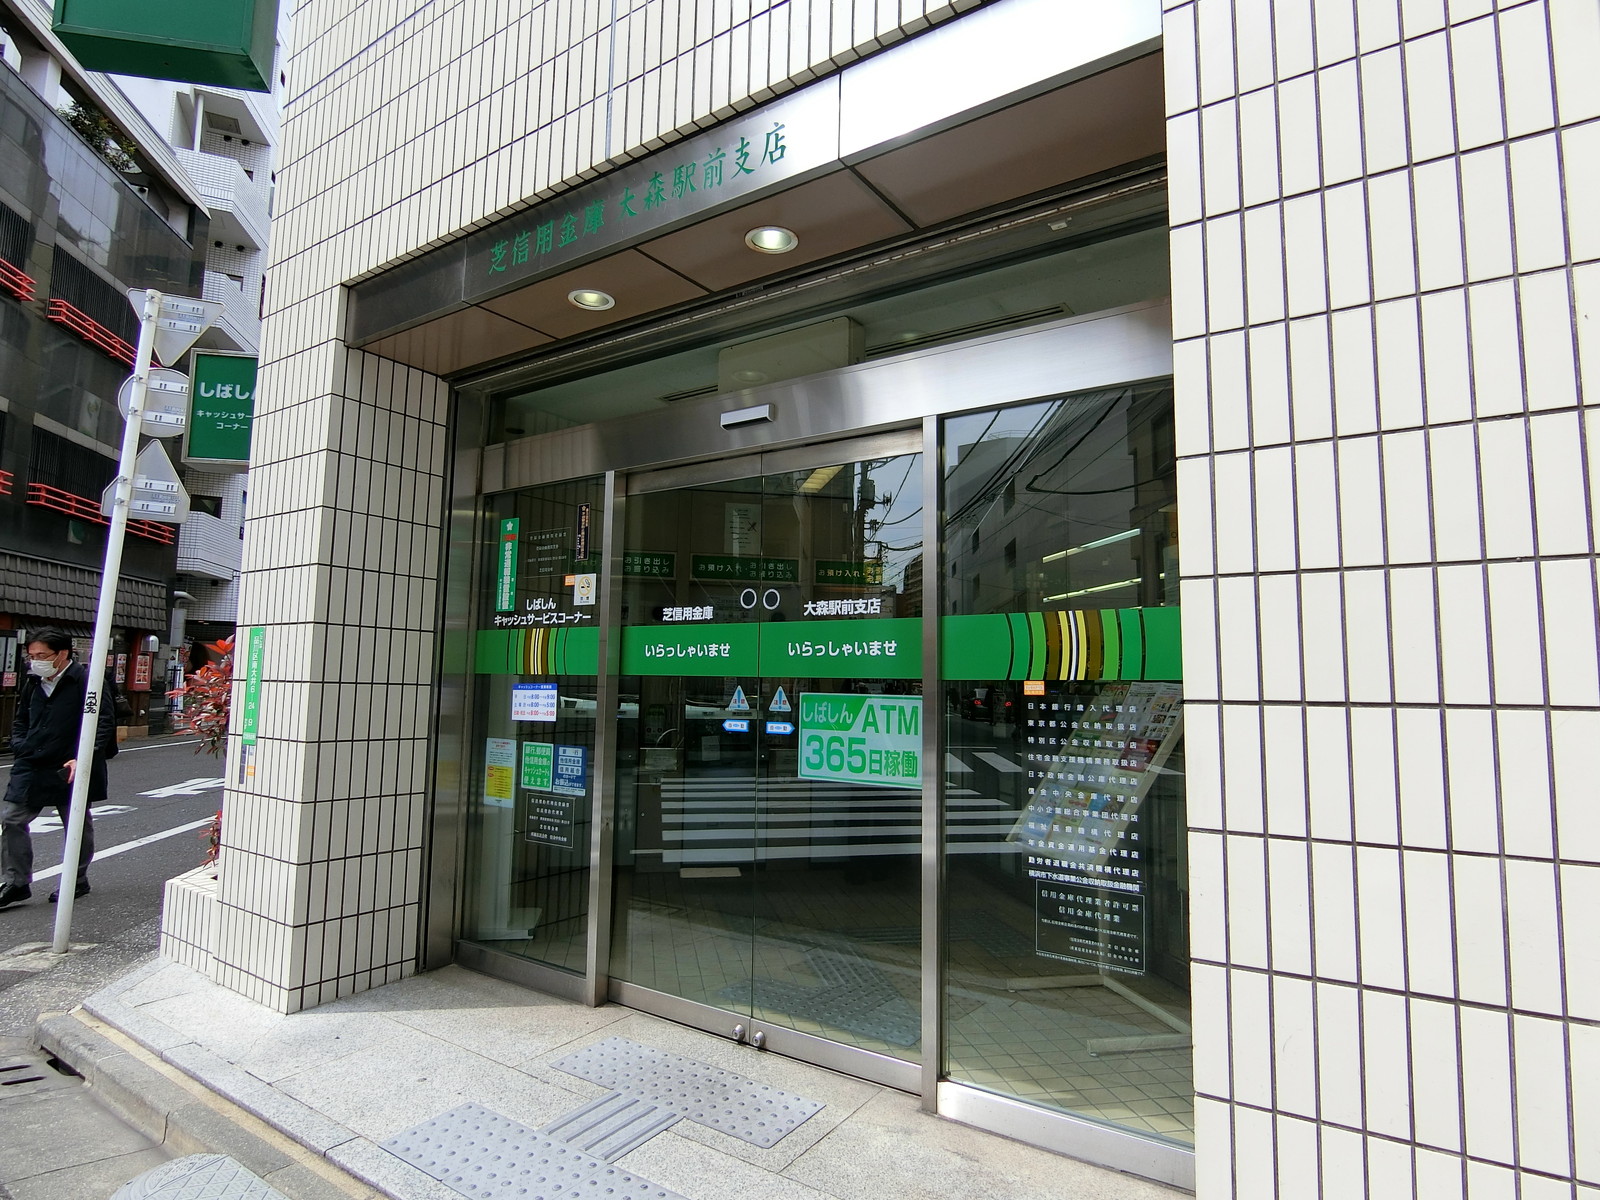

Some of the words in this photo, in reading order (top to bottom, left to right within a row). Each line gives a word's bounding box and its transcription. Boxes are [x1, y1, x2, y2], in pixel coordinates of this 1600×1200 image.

[488, 198, 606, 275] 芝信用金庫
[616, 122, 788, 219] 大森駅前支店
[199, 381, 256, 400] しばし
[216, 422, 248, 430] コーナー
[526, 597, 557, 611] しばしん
[803, 598, 882, 617] 大森駅前支店
[494, 611, 592, 627] キャッシュサービスコーナー
[662, 605, 714, 622] 芝信用金庫
[644, 642, 731, 659] いらっしゃいませ
[787, 639, 898, 658] いらっしゃいませ
[1027, 702, 1137, 713] 日本銀行歳入代理店
[802, 701, 854, 724] しばしん
[861, 704, 919, 736] ATM
[1027, 719, 1137, 731] 東京都公金収納取扱店
[1027, 736, 1137, 749] 特別区公金収納取扱店
[805, 734, 918, 778] 365日稼働
[1058, 905, 1121, 923] 信用金庫代理業
